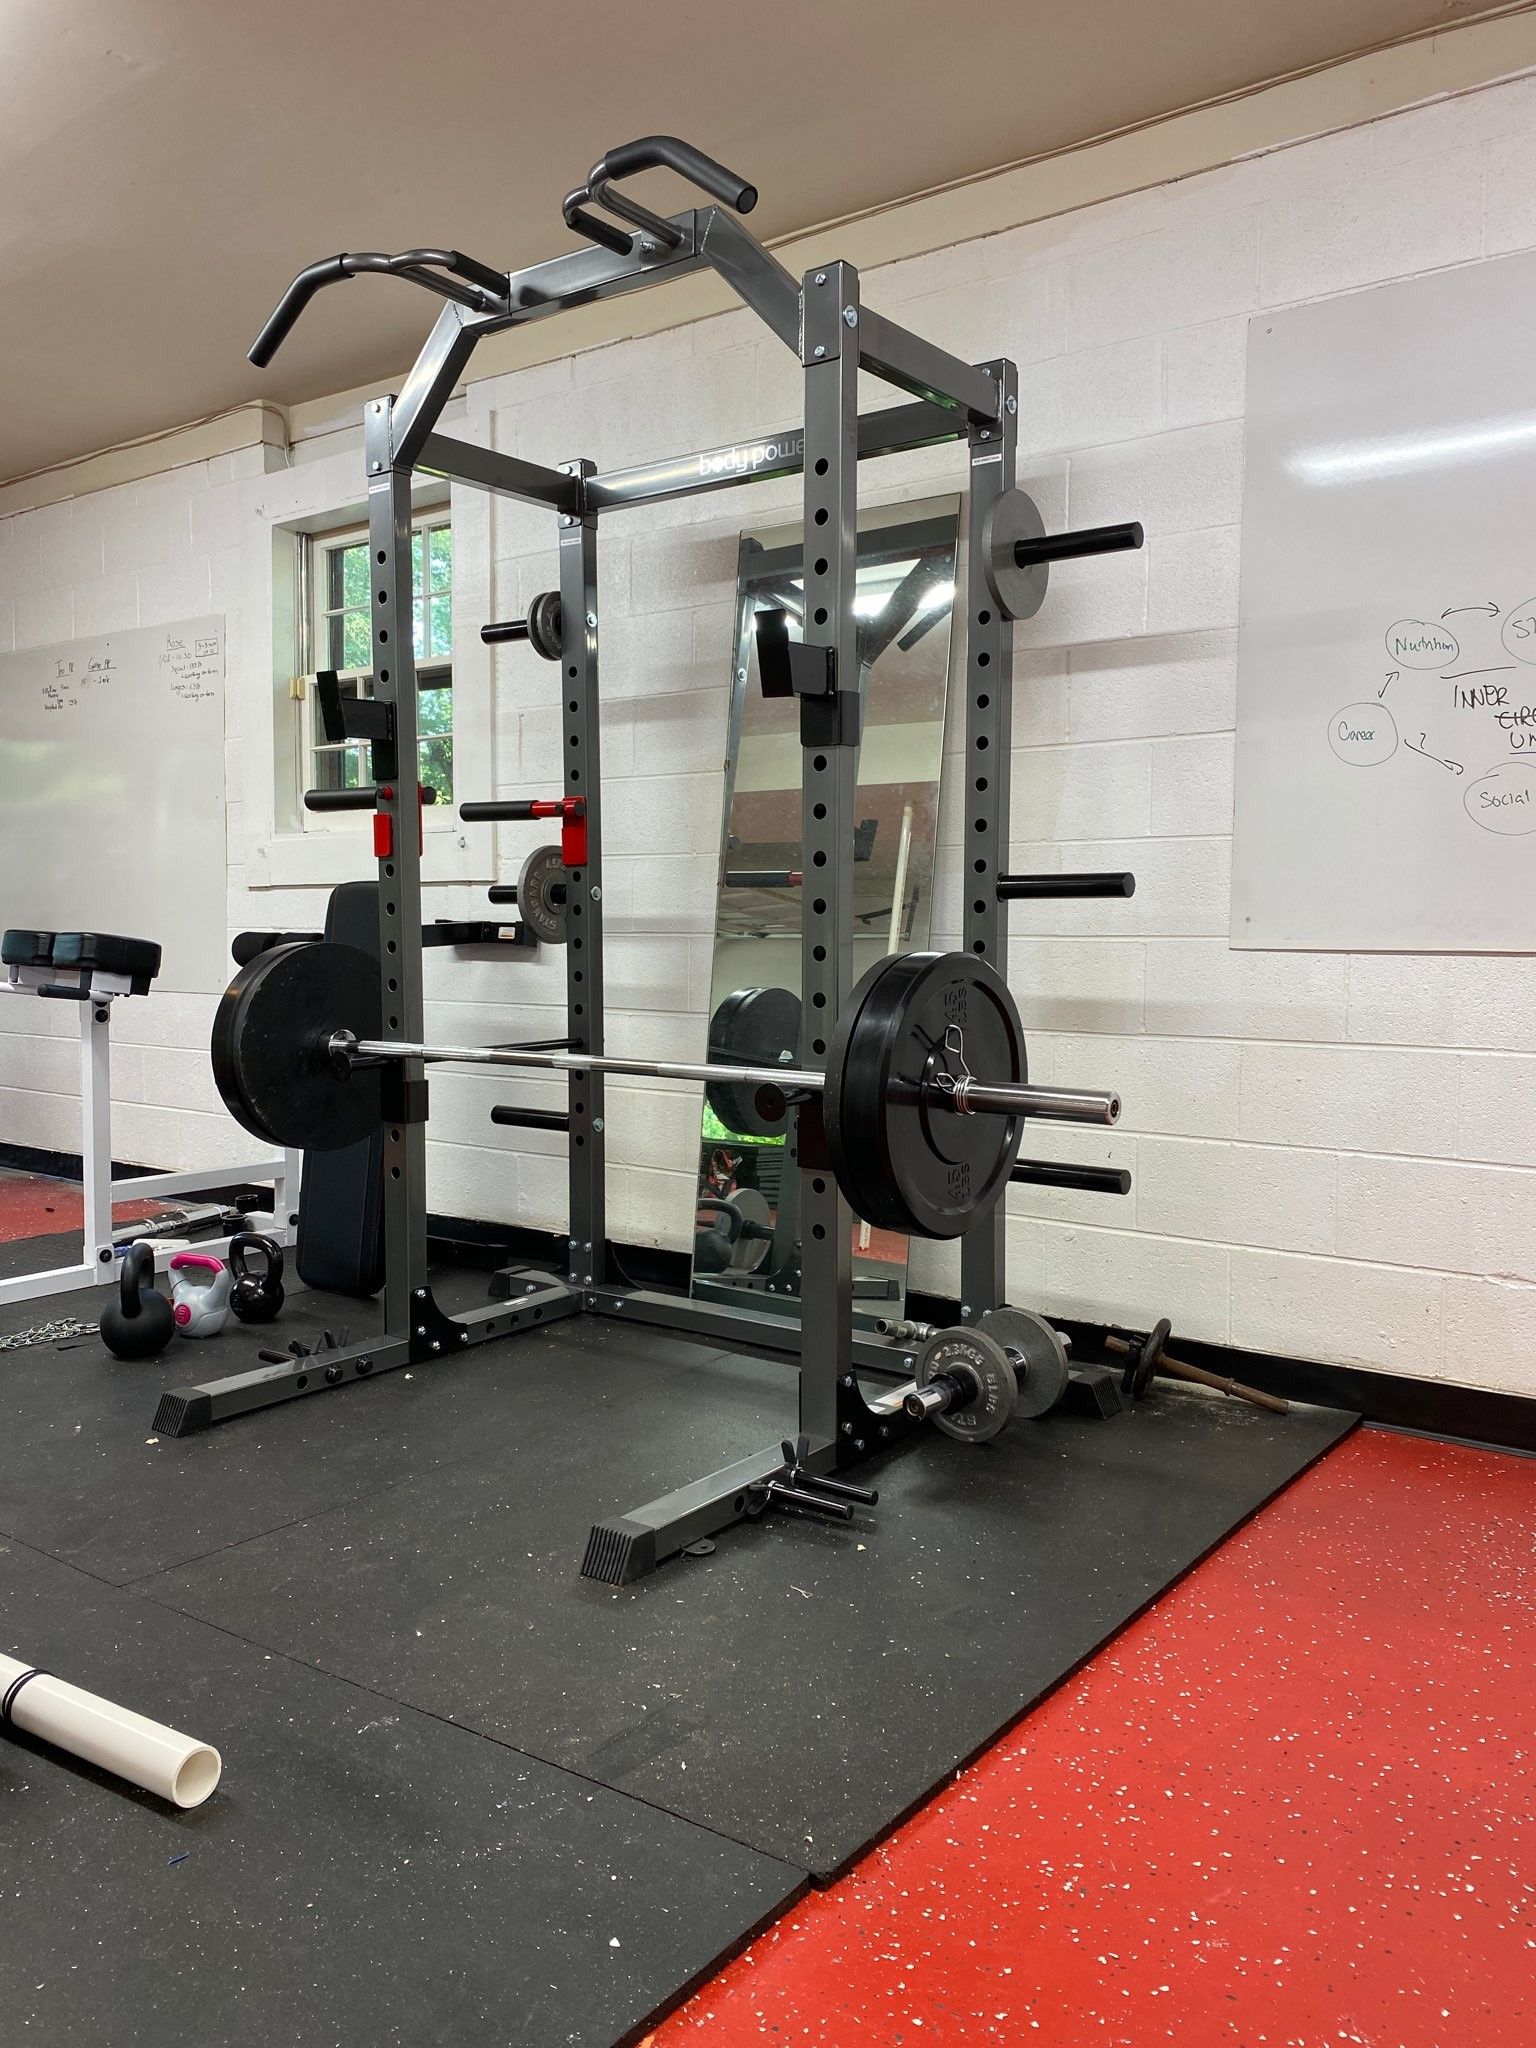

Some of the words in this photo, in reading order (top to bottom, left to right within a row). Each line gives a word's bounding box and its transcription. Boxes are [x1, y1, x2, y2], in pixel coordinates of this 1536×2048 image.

[699, 447, 748, 476] body
[752, 438, 804, 470] powe
[1454, 684, 1510, 709] INNER
[1338, 721, 1376, 742] Career
[1480, 789, 1530, 809] Social
